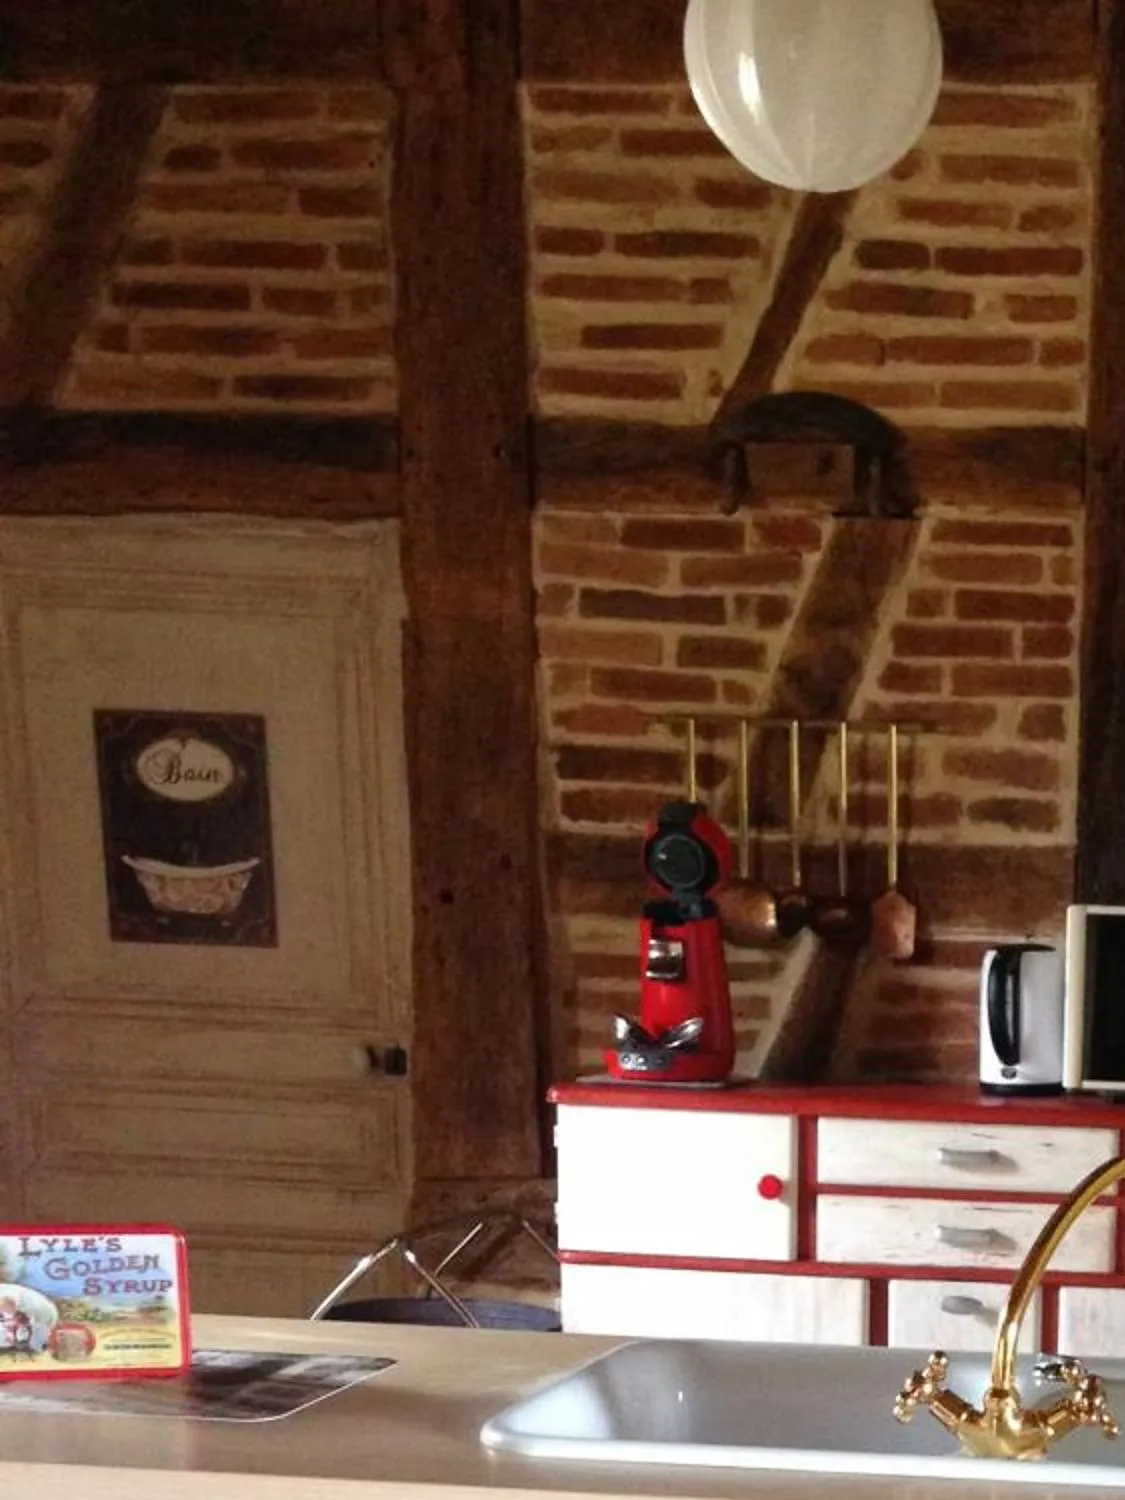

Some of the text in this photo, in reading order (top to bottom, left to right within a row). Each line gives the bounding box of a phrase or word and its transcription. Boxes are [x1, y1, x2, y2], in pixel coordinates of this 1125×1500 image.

[144, 750, 219, 785] Bain
[18, 1237, 123, 1256] LYLE'S
[44, 1254, 160, 1280] GOLDEN
[83, 1277, 173, 1296] SYRUP
